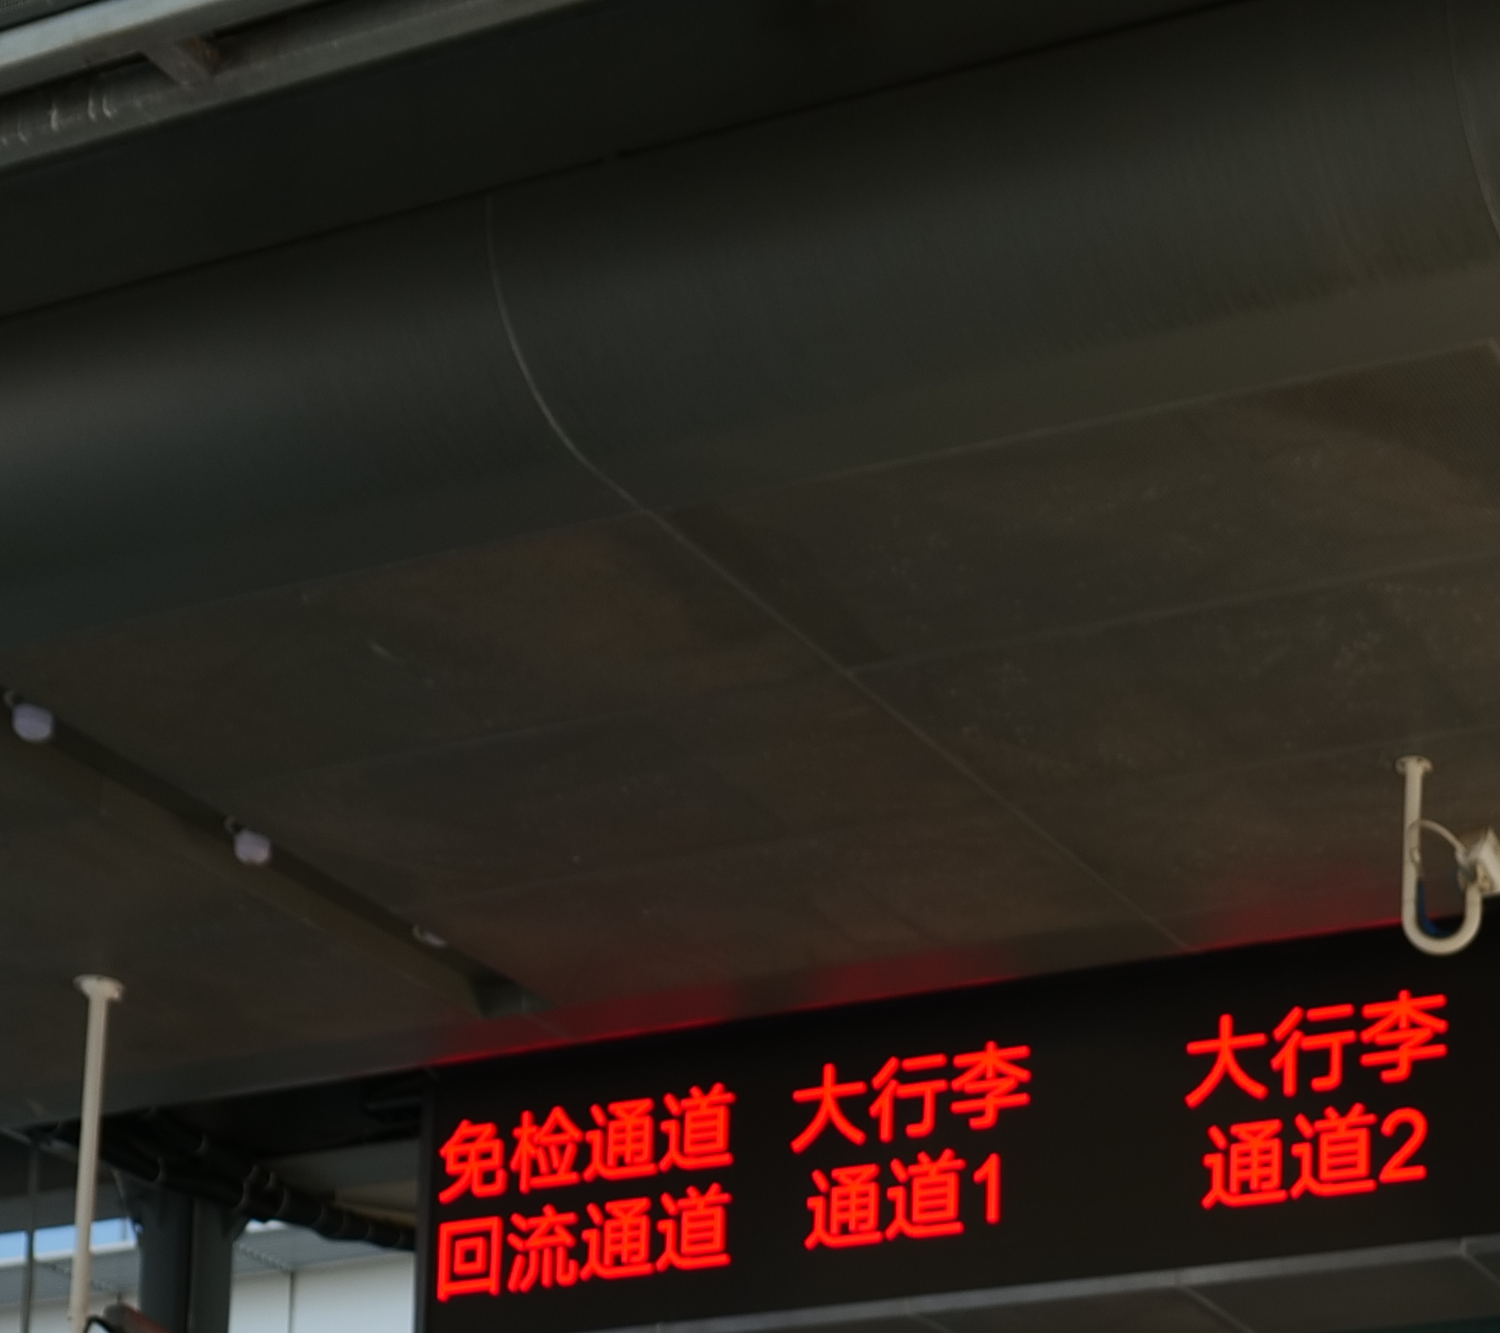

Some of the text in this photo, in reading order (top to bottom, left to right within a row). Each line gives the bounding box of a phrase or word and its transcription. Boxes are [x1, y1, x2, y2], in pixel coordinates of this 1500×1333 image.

[789, 1039, 1032, 1153] 大行李
[1183, 988, 1448, 1108] 大行李
[437, 1081, 736, 1204] 免检通道
[803, 1147, 1001, 1250] 通道1
[1200, 1101, 1428, 1209] 通道2
[435, 1181, 732, 1302] 回流通道
